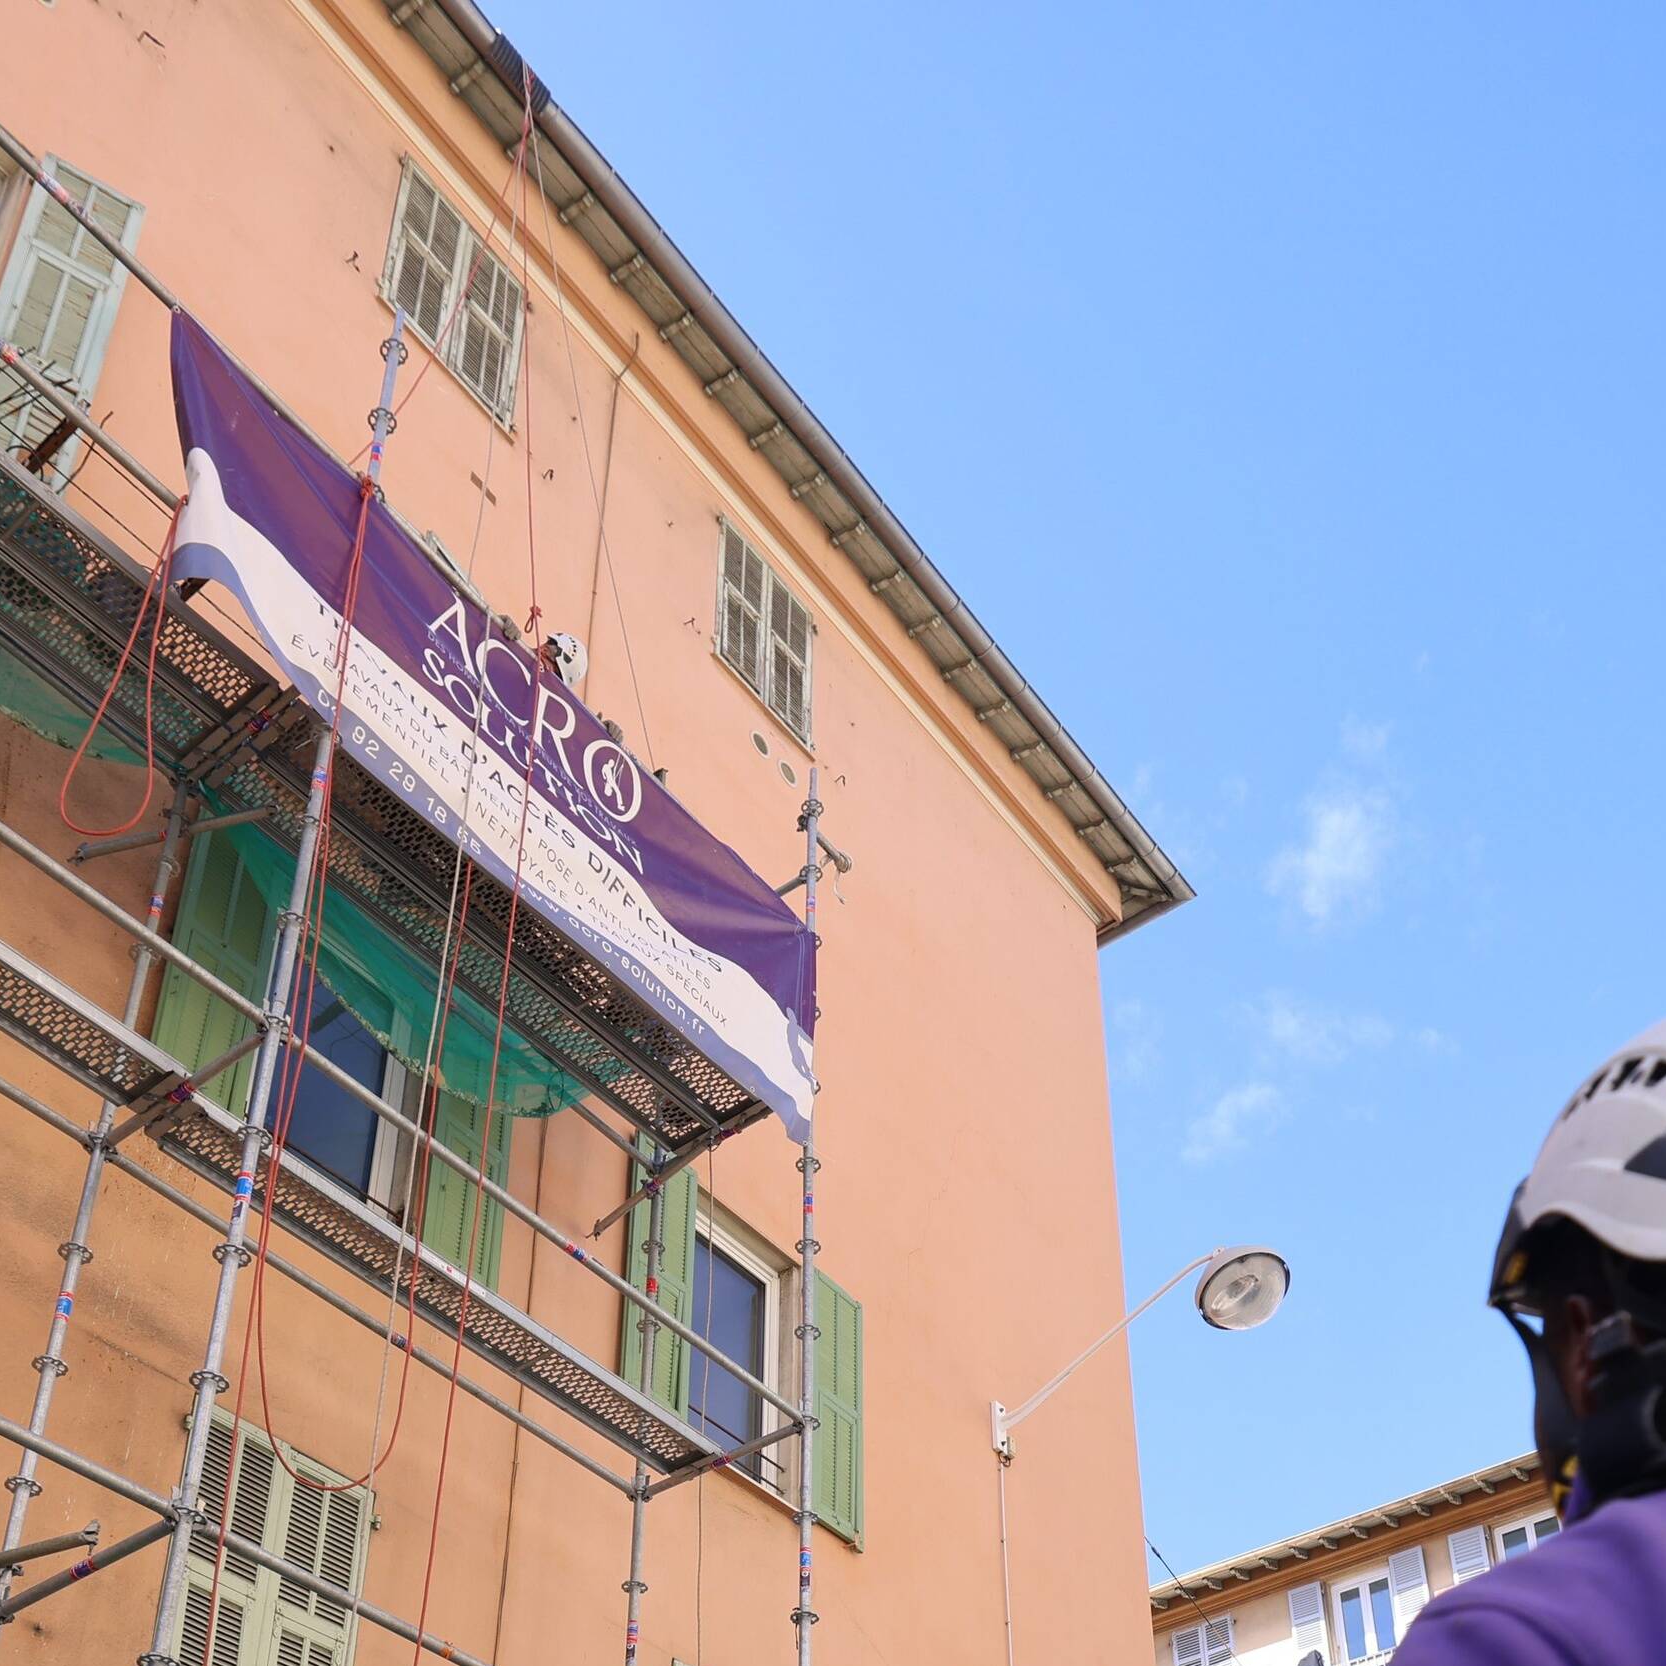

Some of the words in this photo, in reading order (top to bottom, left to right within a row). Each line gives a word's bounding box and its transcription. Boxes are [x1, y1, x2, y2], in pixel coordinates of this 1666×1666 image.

[313, 596, 447, 737] TRAVAUX
[588, 850, 722, 973] DIFFICILES
[326, 639, 404, 717] TRAVAUX
[410, 717, 432, 744] DU
[439, 745, 520, 824] BÂTIMENT
[538, 839, 573, 881] POSE
[422, 648, 644, 875] SOLUTION
[427, 587, 642, 823] ACRO
[352, 725, 380, 760] 92
[388, 761, 416, 793] 29
[425, 797, 448, 824] 18
[510, 875, 706, 1035] www.acro-solution.fr
[475, 801, 569, 903] NETTOYAGE
[588, 912, 662, 966] TRAVAUX
[665, 963, 728, 1027] SPÉCIAUX
